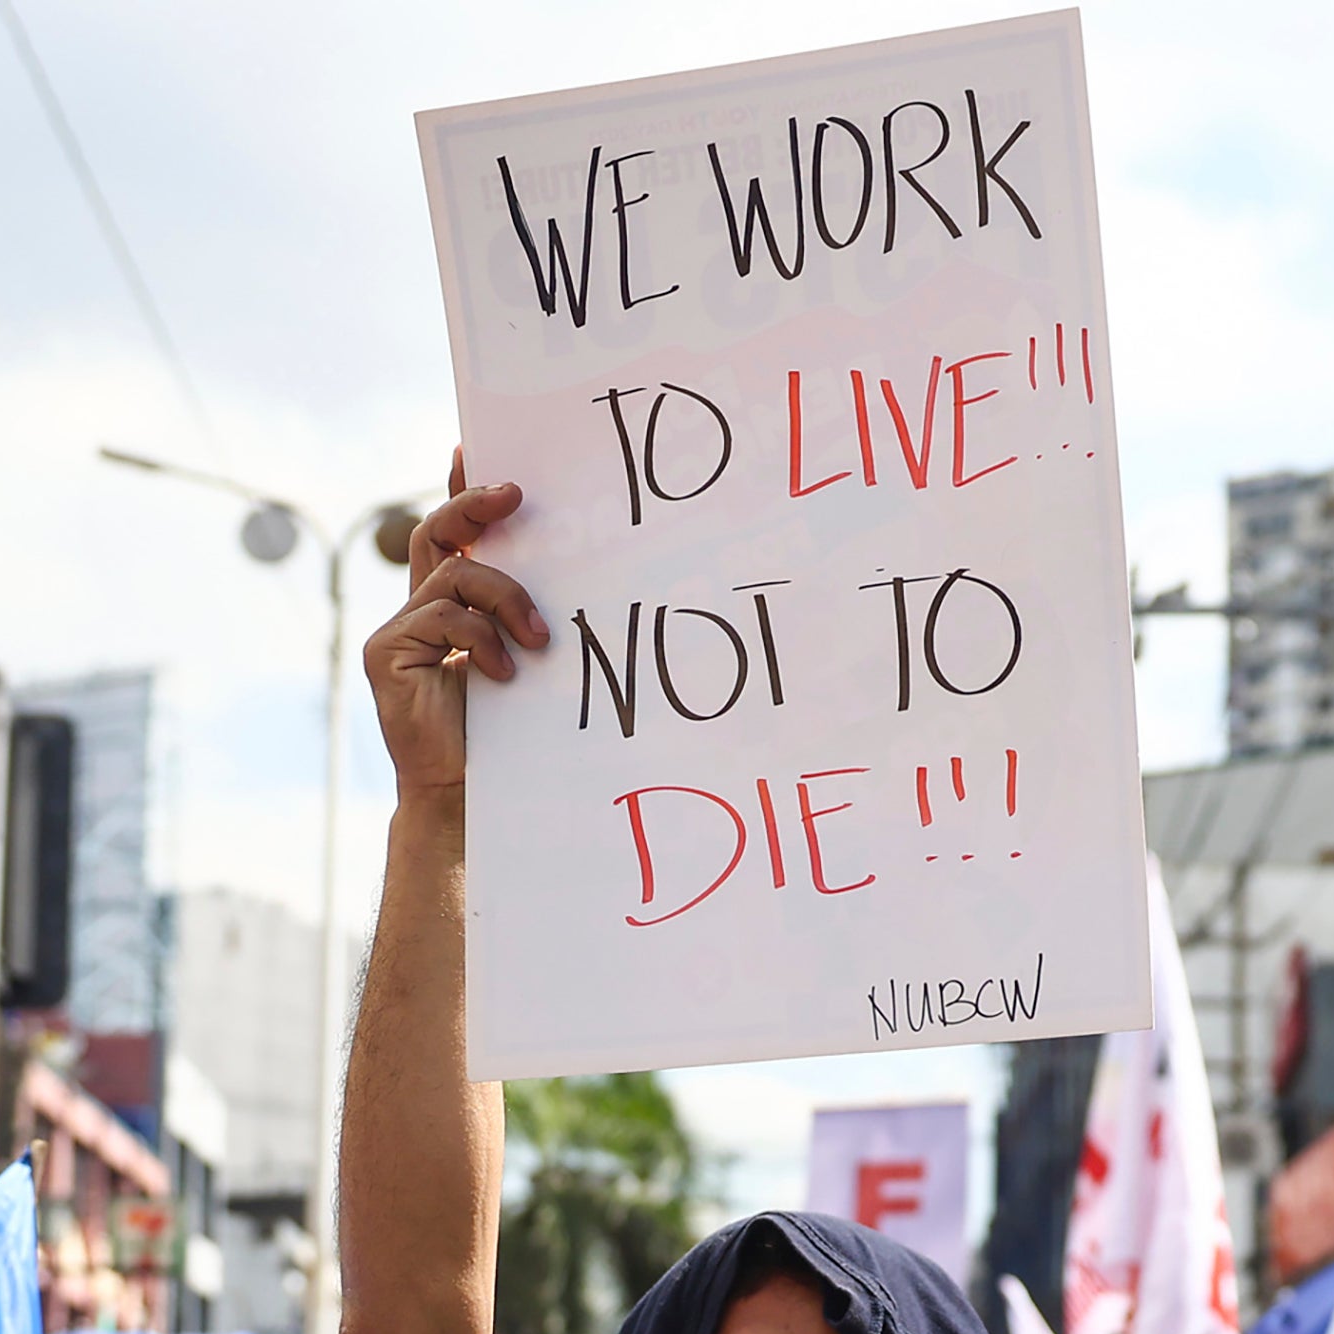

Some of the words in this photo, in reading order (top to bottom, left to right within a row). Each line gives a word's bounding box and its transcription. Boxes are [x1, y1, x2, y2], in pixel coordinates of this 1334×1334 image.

[497, 145, 679, 328] WE
[708, 89, 1043, 280] WORK
[592, 382, 733, 526] TO
[787, 323, 1096, 498] LIVE!!!
[570, 579, 792, 738] NOT
[858, 568, 1023, 711] TO
[613, 748, 1023, 927] DIE!!!
[868, 953, 1044, 1041] NUBCW
